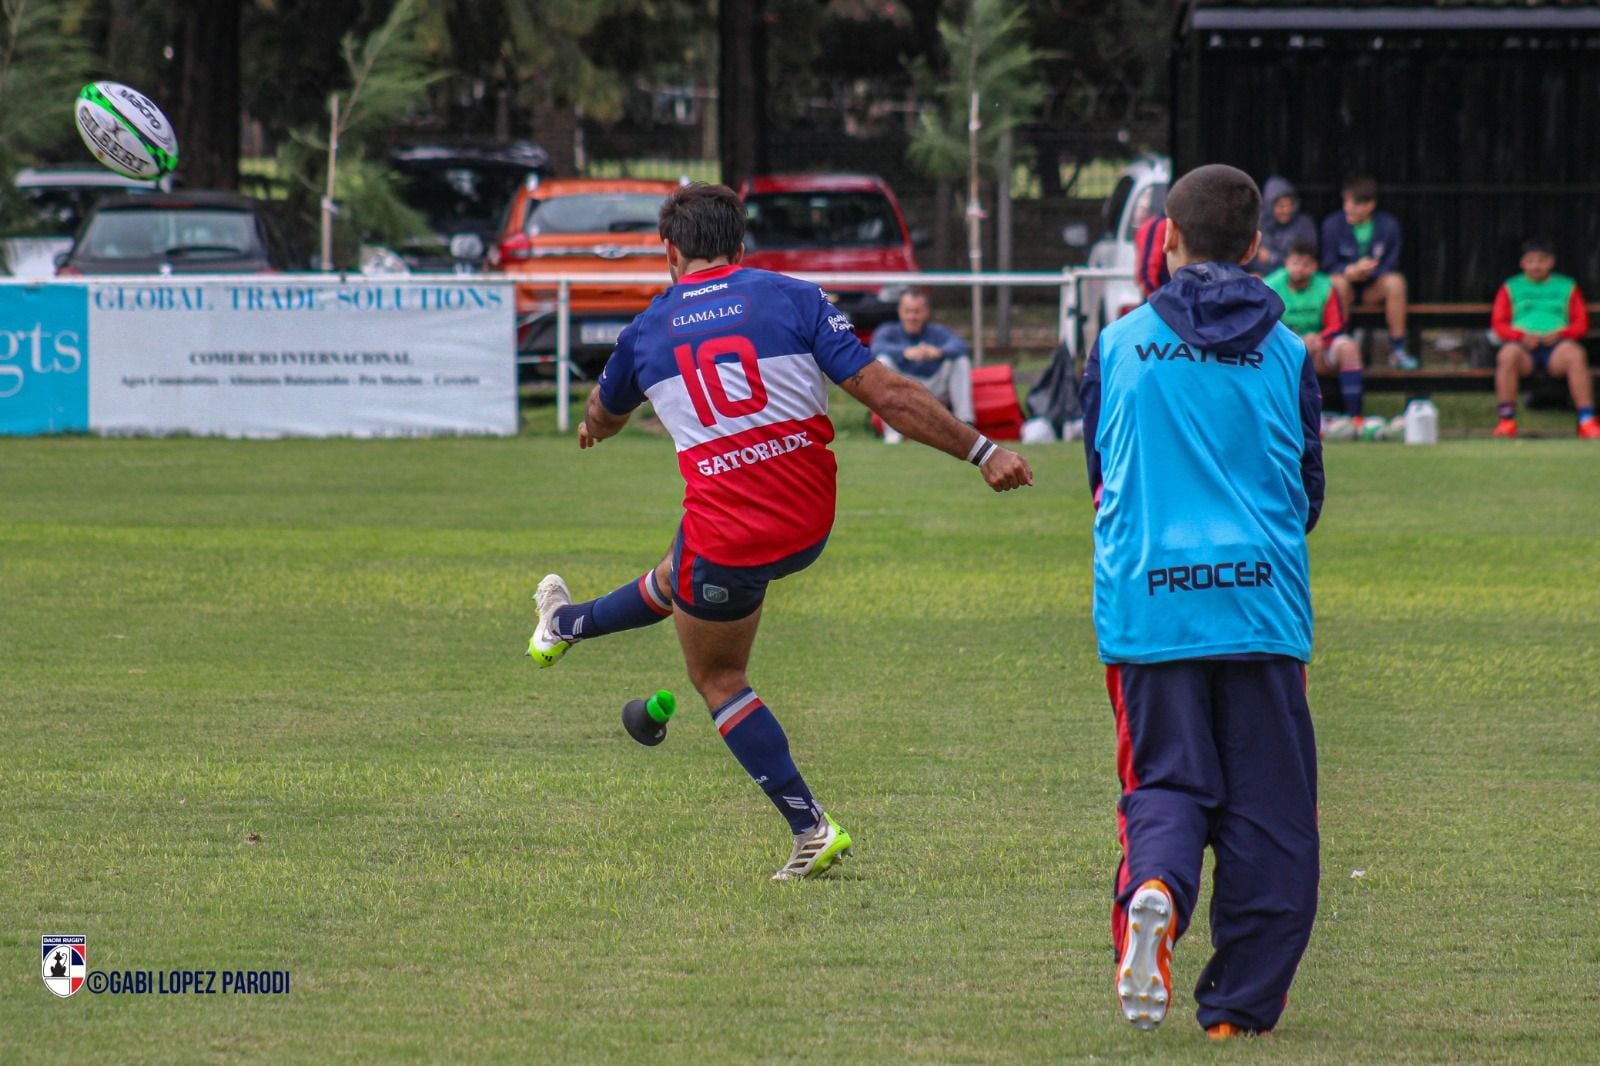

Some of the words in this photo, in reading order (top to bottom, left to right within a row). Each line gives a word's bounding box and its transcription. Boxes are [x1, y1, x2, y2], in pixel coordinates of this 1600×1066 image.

[95, 286, 214, 311] GLOBAL
[226, 287, 325, 311] TRADE
[337, 286, 502, 311] SOLUTIONS
[682, 282, 729, 300] PROCER
[672, 303, 744, 328] CLAMA-LAC
[189, 352, 278, 366] COMERCIO
[282, 352, 412, 366] INTERNACIONAL
[673, 335, 769, 428] 10
[697, 431, 813, 477] GATORADE
[1147, 561, 1275, 597] PROCER
